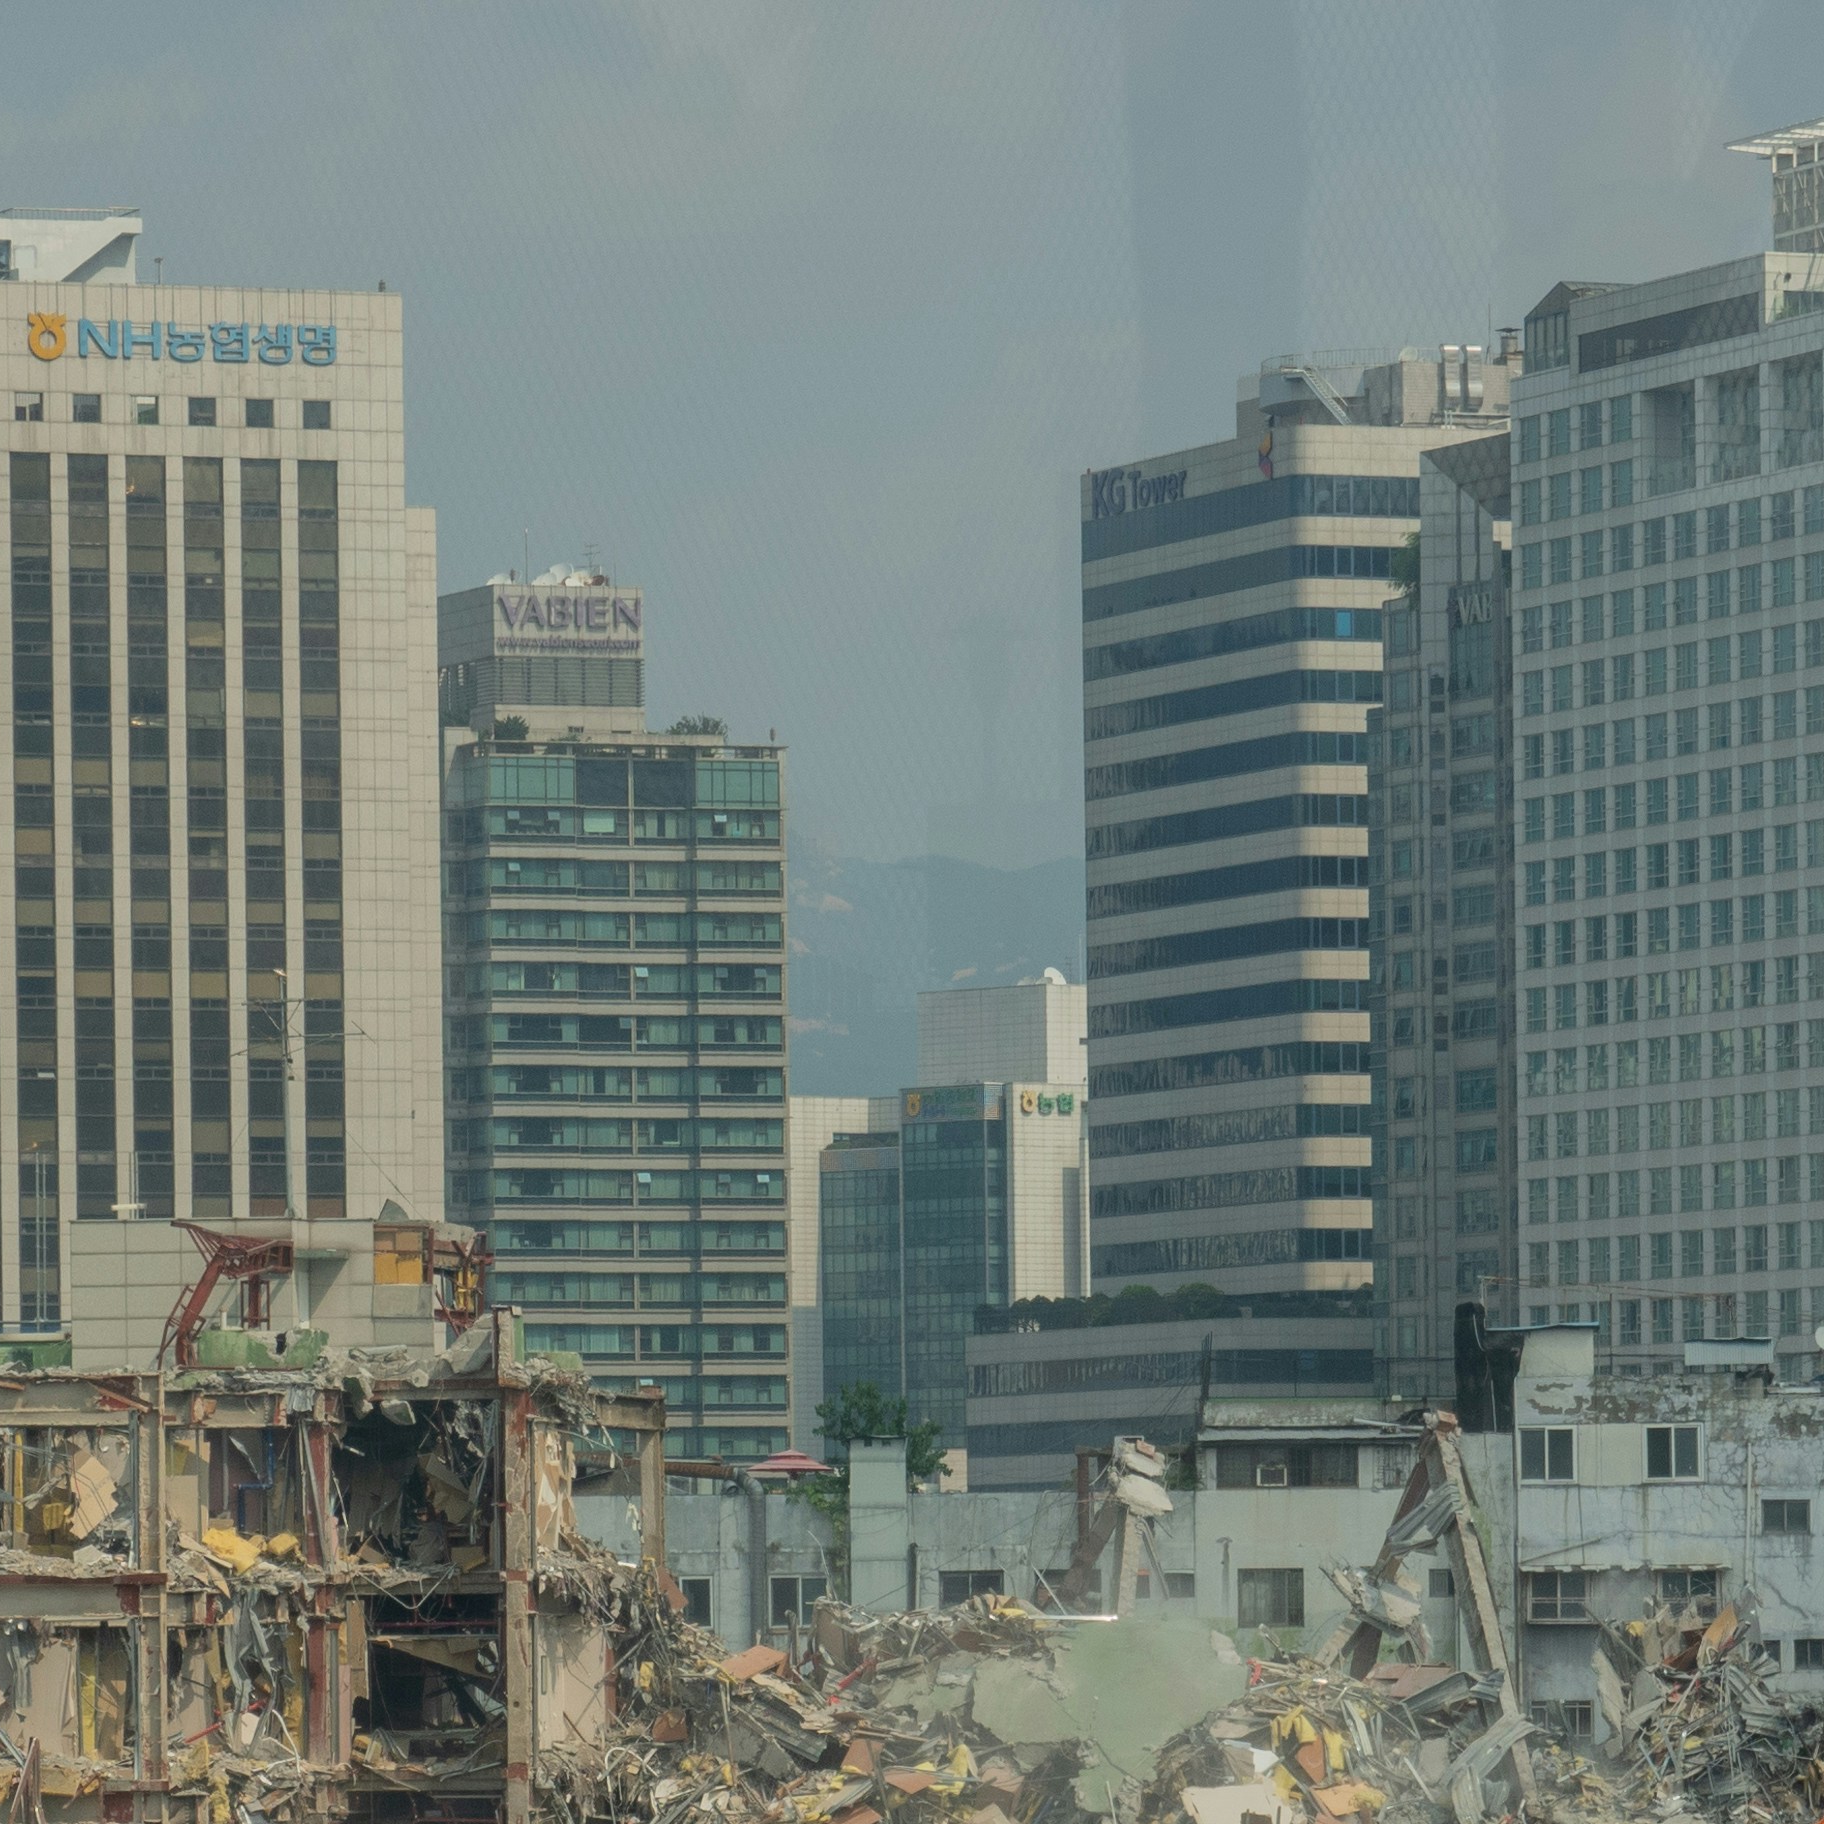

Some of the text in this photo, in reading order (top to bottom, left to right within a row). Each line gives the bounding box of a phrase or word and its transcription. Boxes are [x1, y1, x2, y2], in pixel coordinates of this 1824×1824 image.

[78, 317, 337, 366] NH농협생명
[1091, 467, 1188, 520] KG Tower
[498, 593, 642, 634] VABIEN
